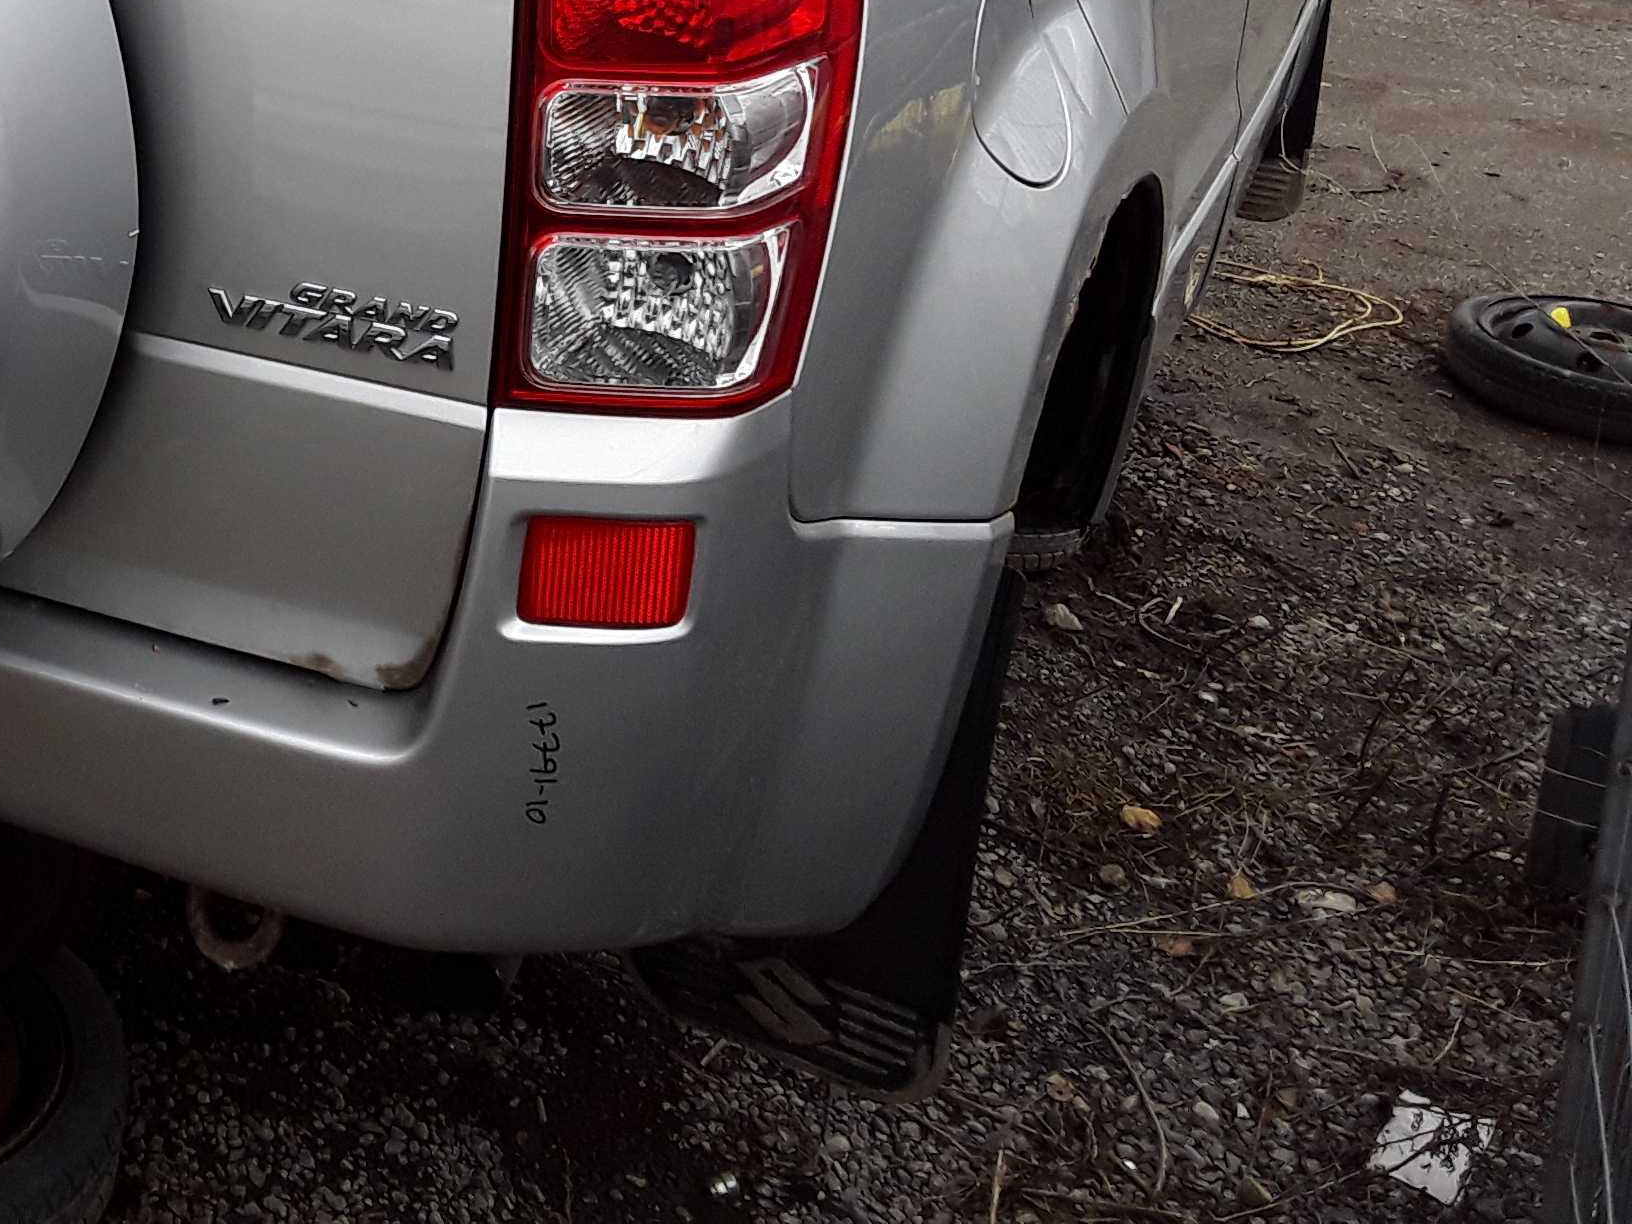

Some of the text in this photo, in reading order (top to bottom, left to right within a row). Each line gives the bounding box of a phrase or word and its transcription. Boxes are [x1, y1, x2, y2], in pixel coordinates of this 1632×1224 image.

[208, 286, 455, 371] VITARA
[289, 281, 460, 333] GRAND
[526, 702, 560, 824] 17791-10
